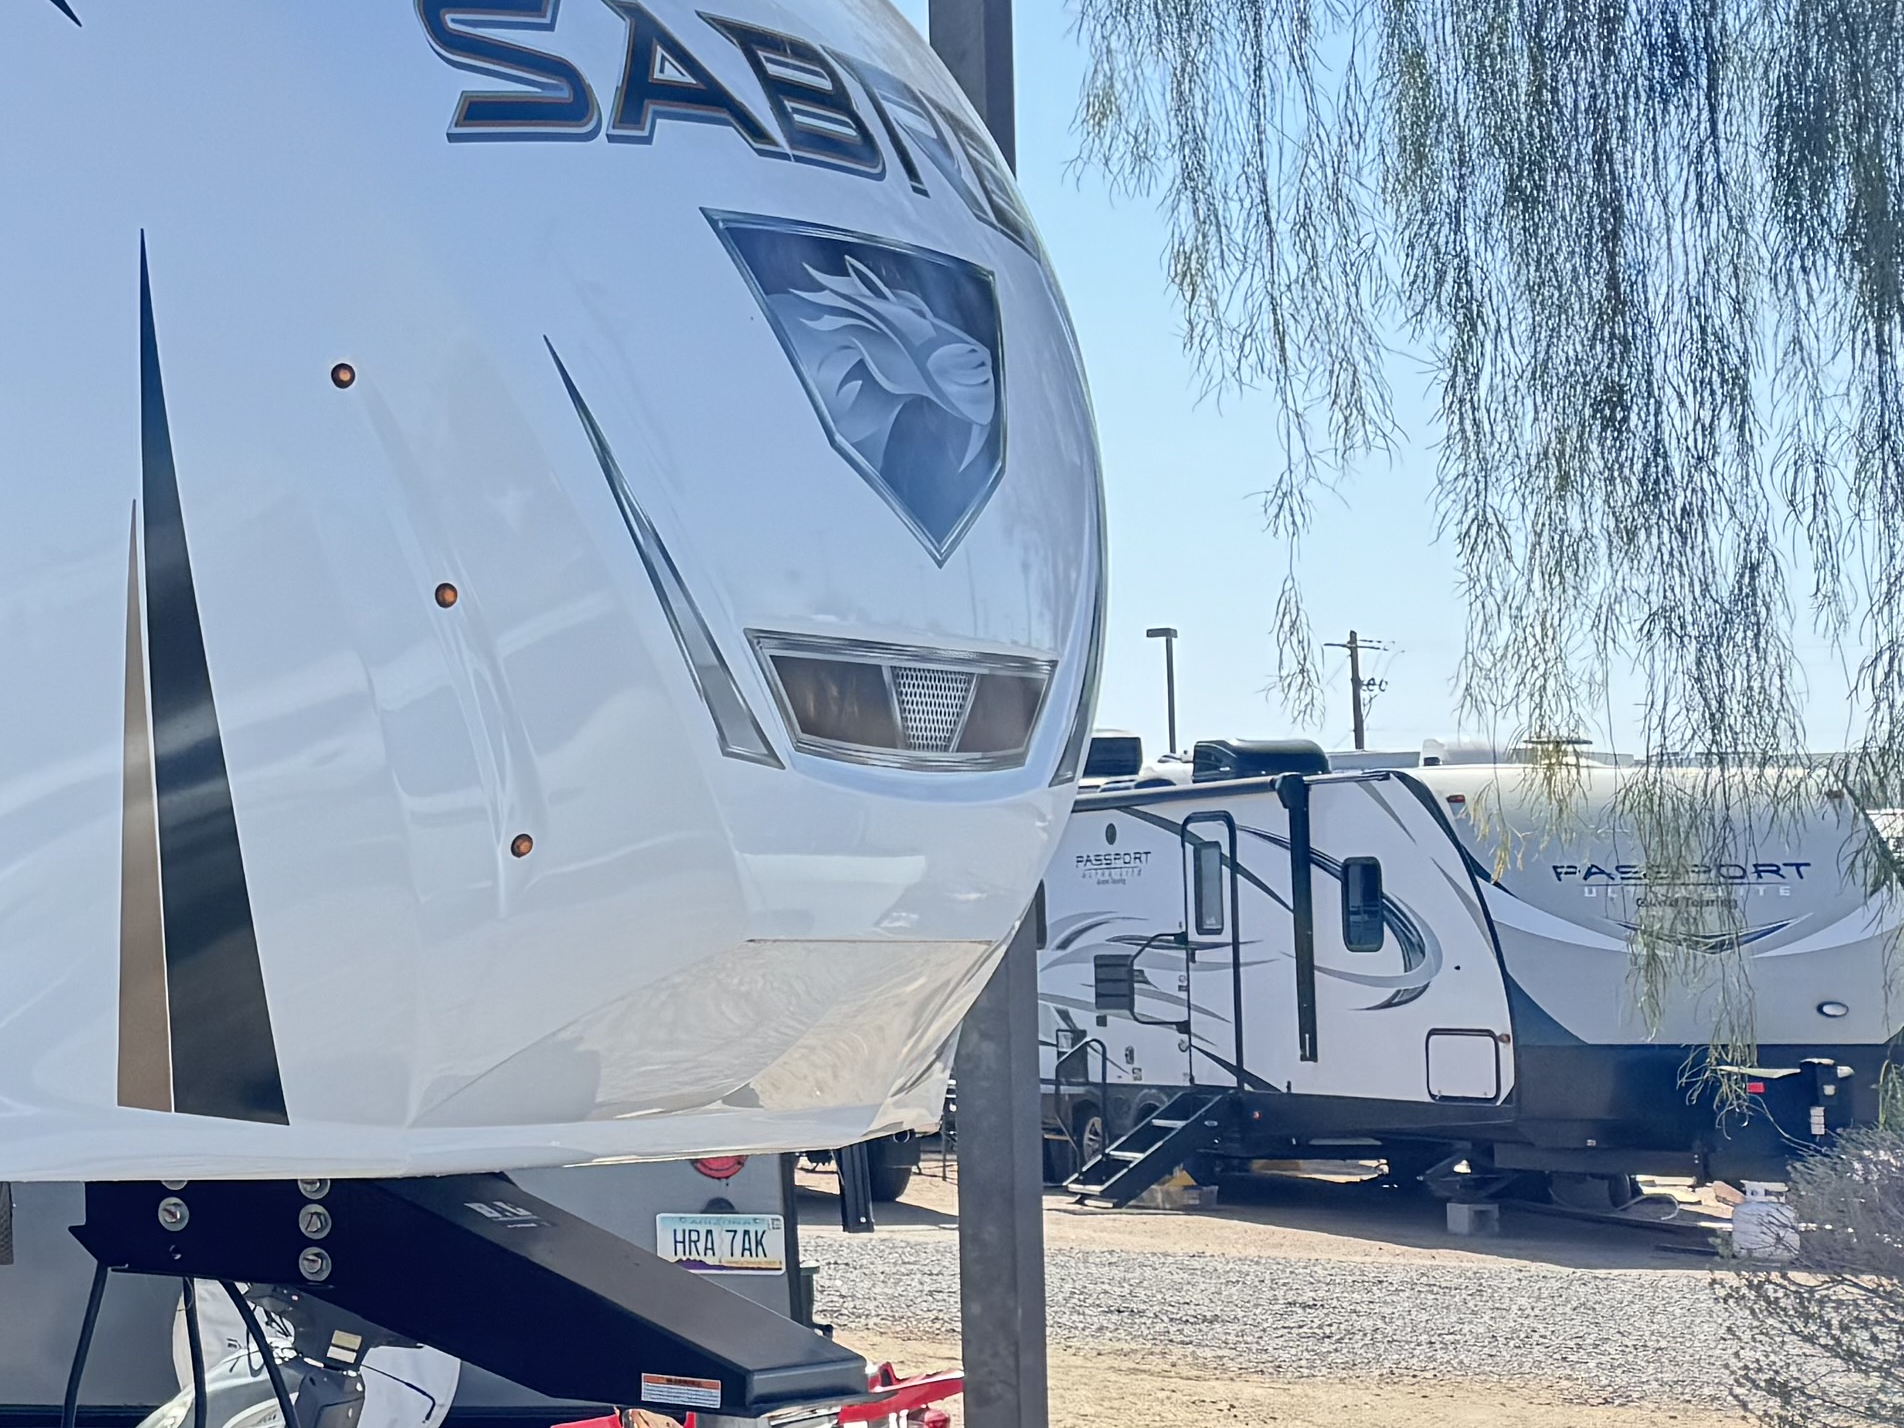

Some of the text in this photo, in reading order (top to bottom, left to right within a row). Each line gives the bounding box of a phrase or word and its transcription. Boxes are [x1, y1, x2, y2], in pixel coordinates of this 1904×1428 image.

[1076, 851, 1151, 868] PASSPORT
[673, 1228, 768, 1258] HRA 7AK
